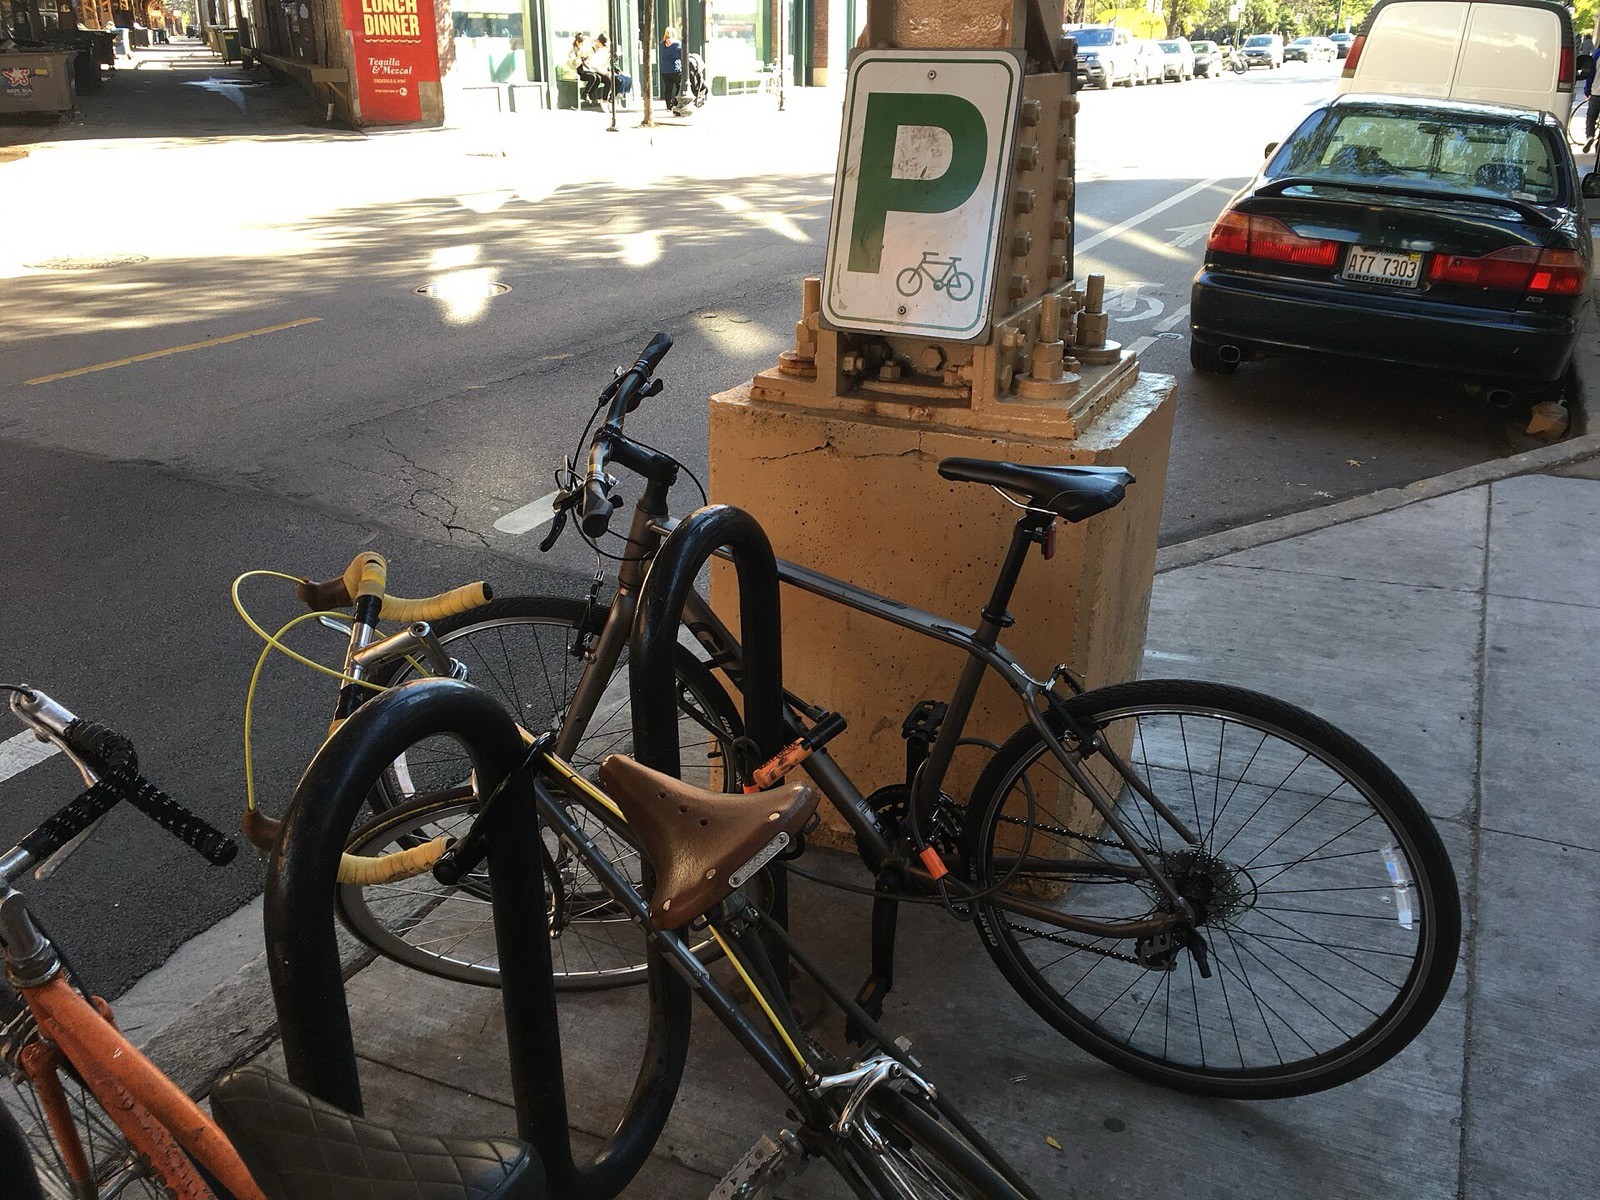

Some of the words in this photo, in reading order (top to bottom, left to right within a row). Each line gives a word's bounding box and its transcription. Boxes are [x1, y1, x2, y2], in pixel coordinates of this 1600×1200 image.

[362, 0, 418, 13] LUNCH
[363, 14, 420, 36] DINNER
[368, 57, 400, 68] Tequila
[372, 66, 380, 74] &
[382, 66, 412, 75] Mezcal
[847, 92, 988, 274] P
[1348, 254, 1376, 273] A77
[1383, 258, 1417, 278] 7303
[1347, 273, 1412, 287] GROSSINGER
[978, 910, 999, 947] GIANT
